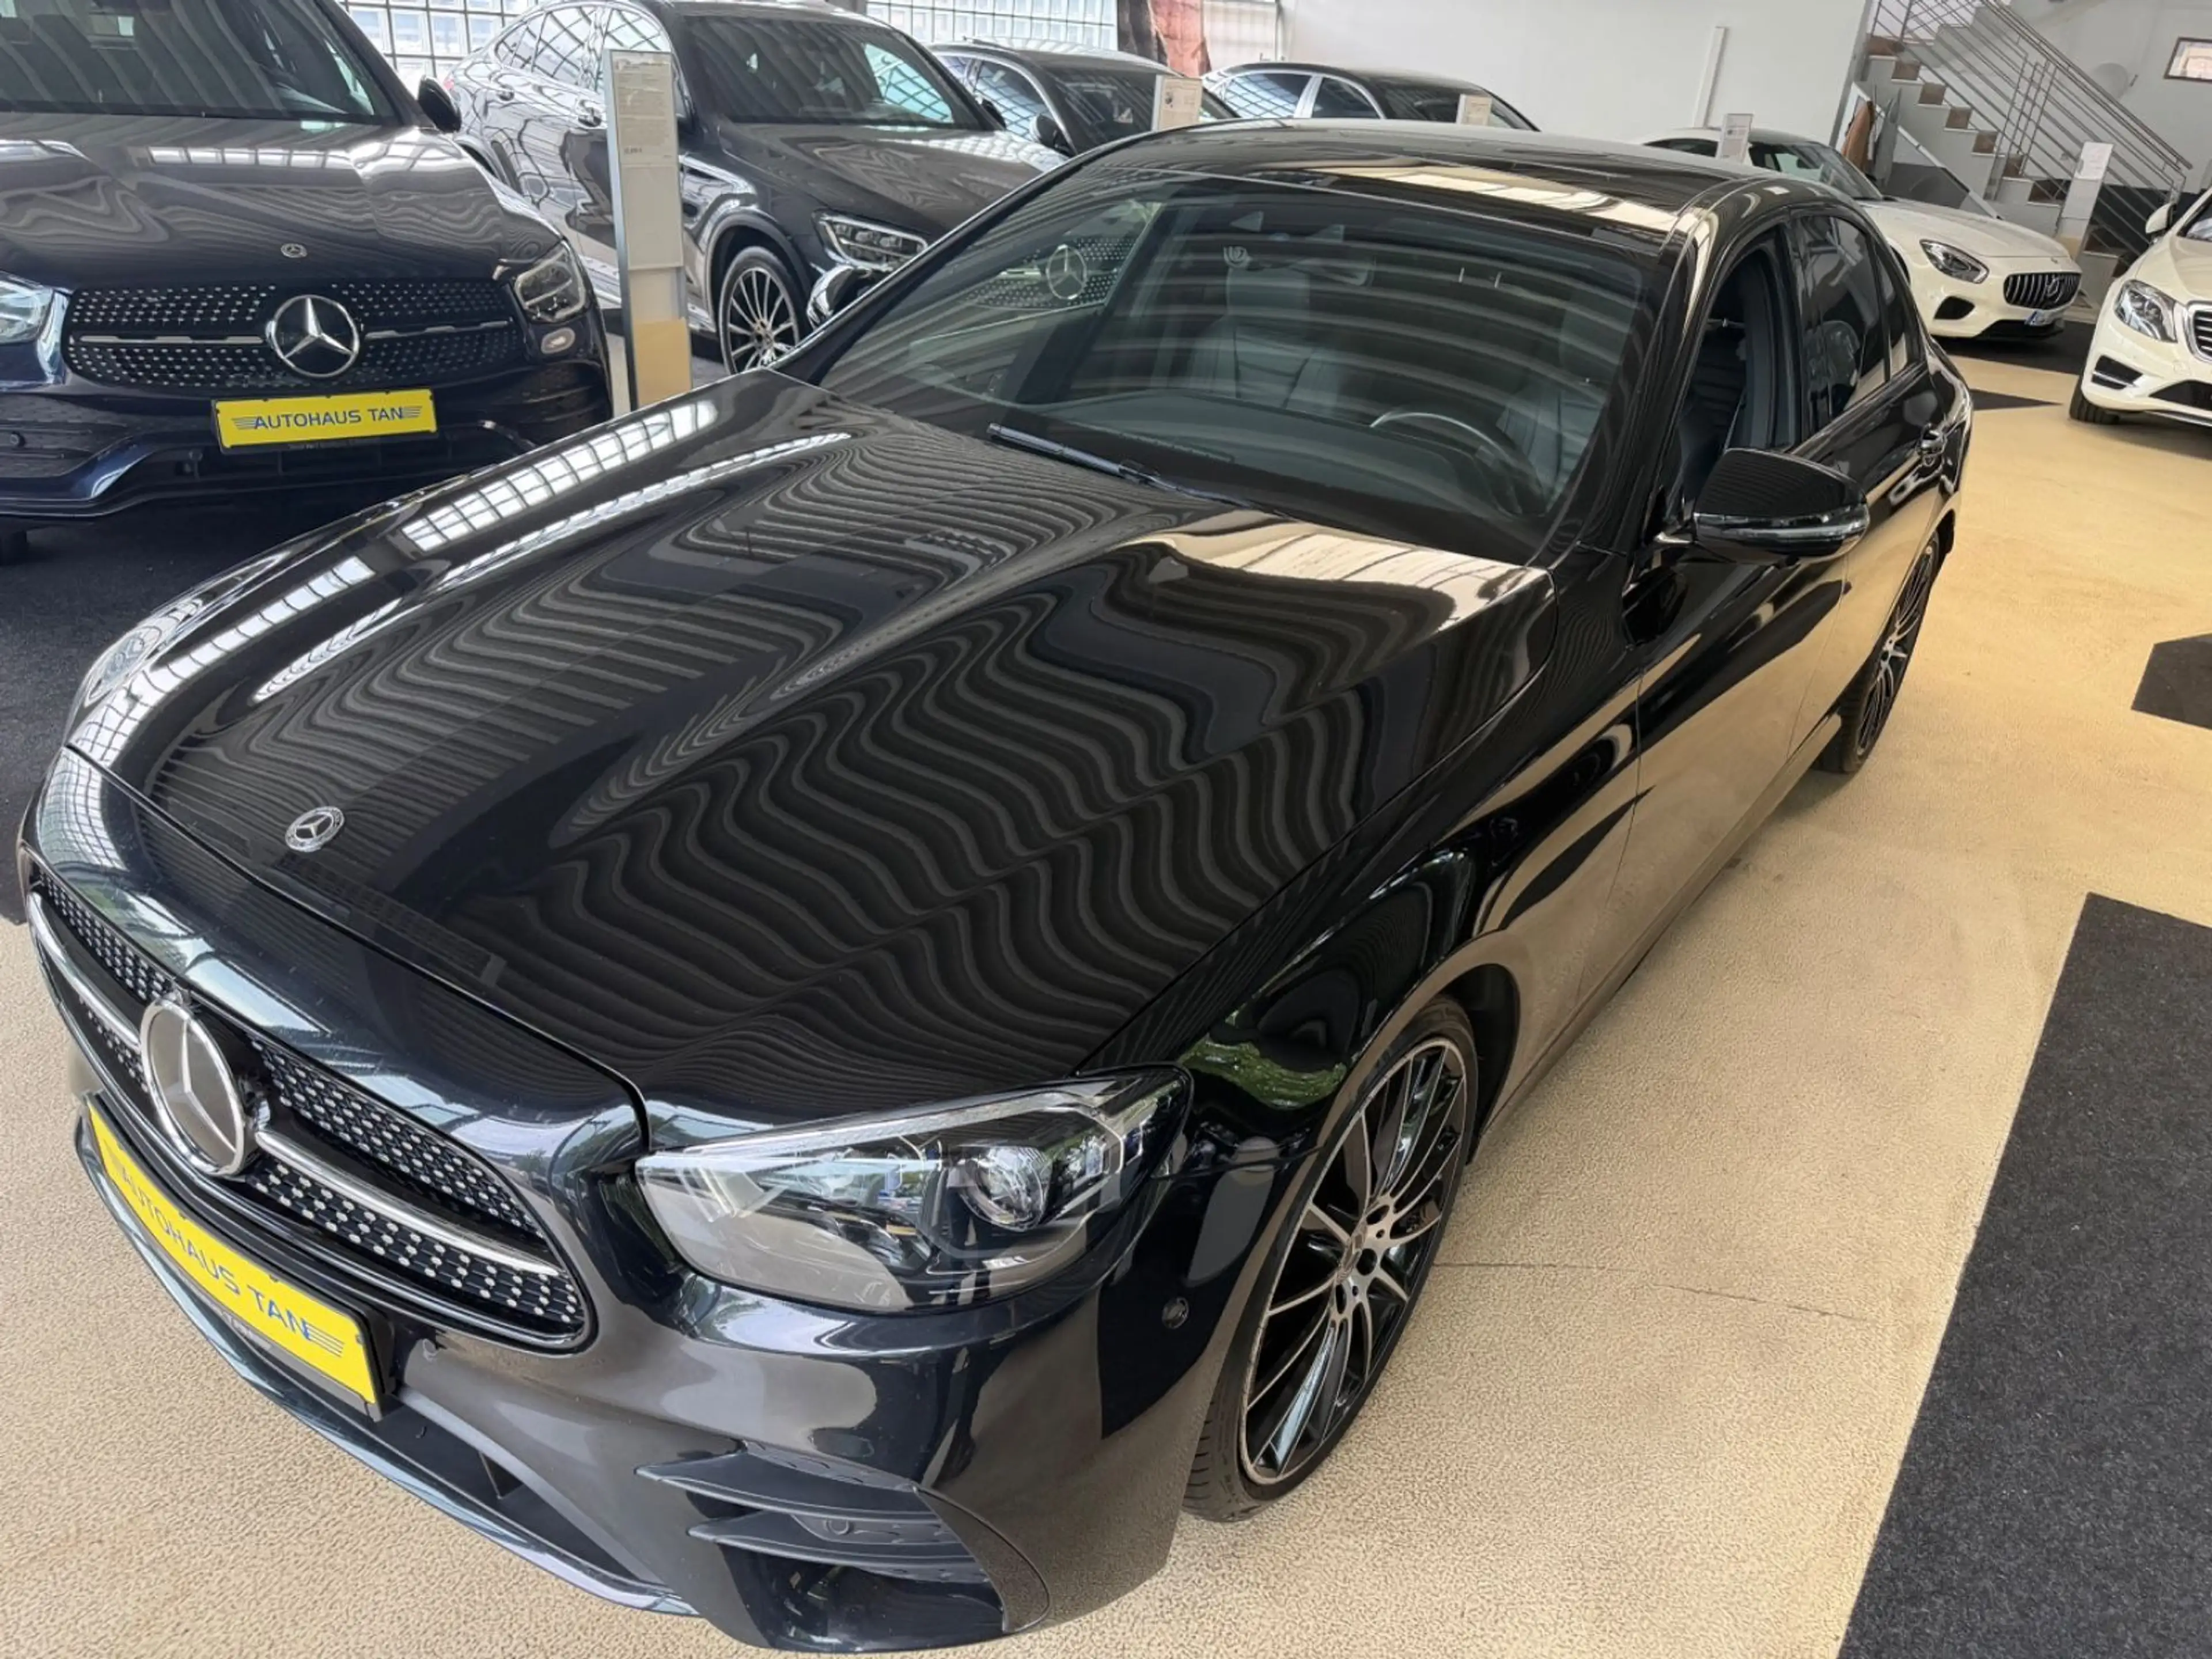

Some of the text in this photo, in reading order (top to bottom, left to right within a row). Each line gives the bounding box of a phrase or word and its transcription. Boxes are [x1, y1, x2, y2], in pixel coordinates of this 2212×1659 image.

[253, 406, 403, 430] AUTOHAUS TAN
[122, 1167, 310, 1340] AUTOHAUS TAN
